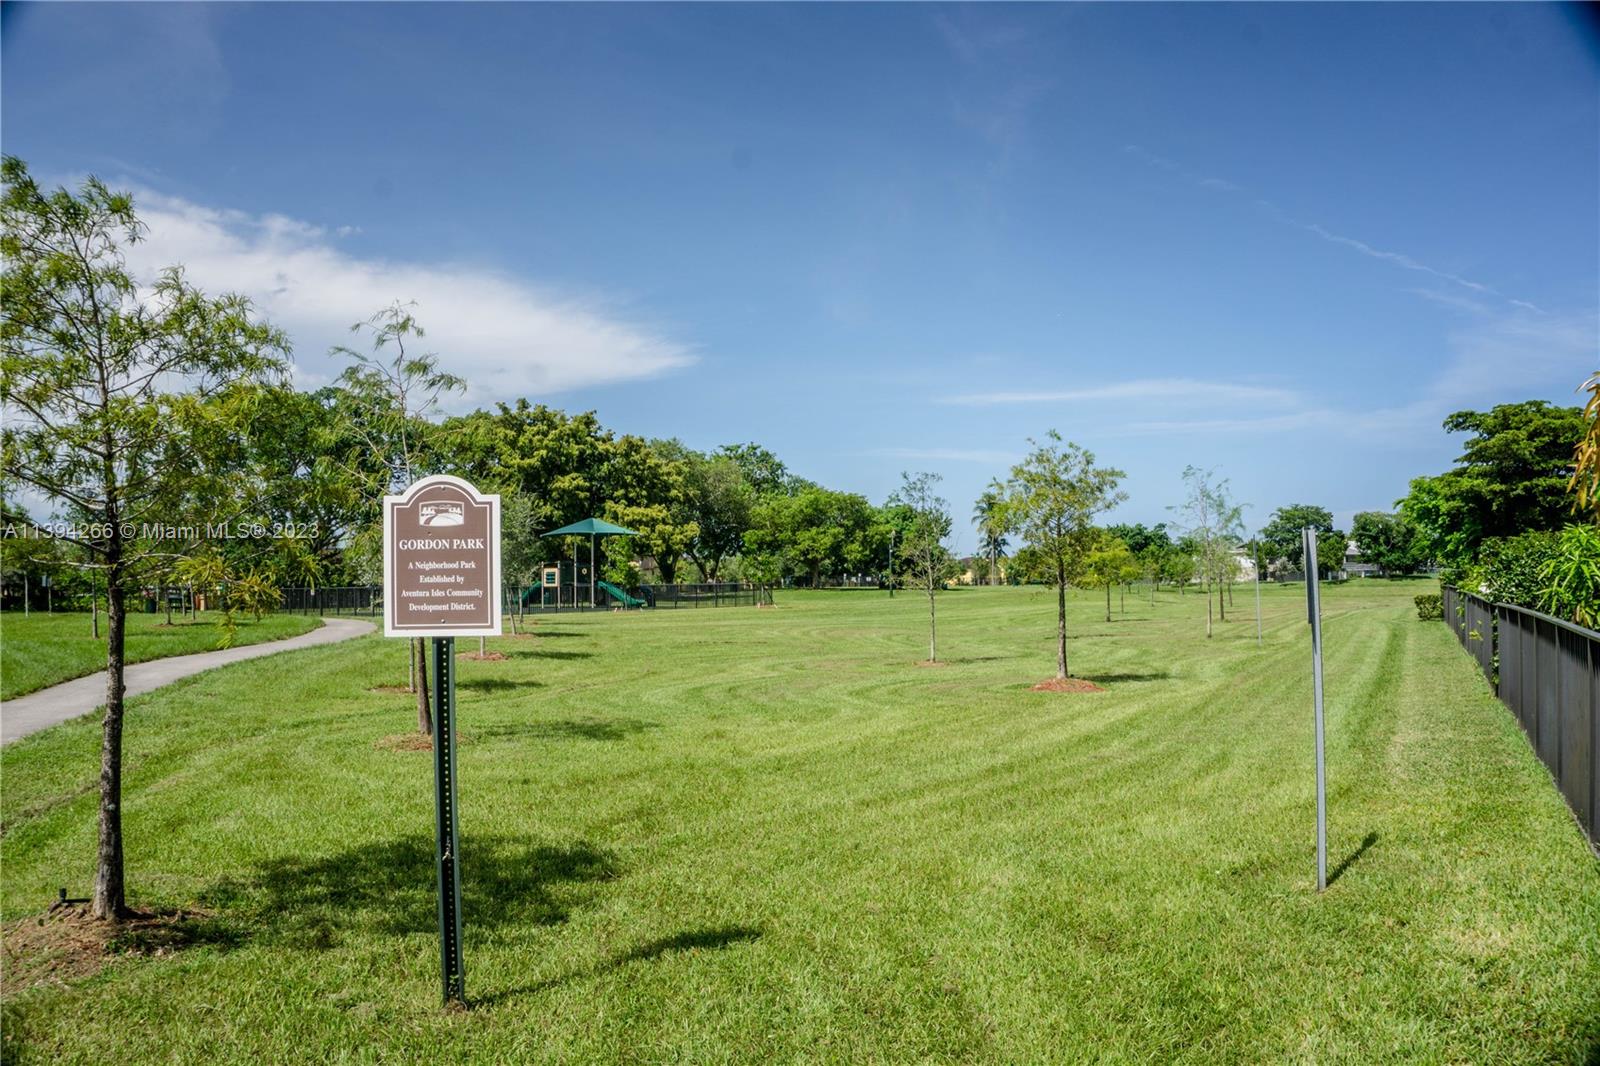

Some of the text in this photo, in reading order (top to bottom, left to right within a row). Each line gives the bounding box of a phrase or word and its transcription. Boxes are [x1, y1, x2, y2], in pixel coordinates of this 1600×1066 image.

[399, 538, 484, 550] GORDON PARK
[415, 561, 459, 571] Neighborhood
[460, 561, 476, 569] Park
[419, 575, 465, 584] Established by
[401, 589, 483, 598] Aventura Isles Community
[409, 603, 476, 612] Development District.
